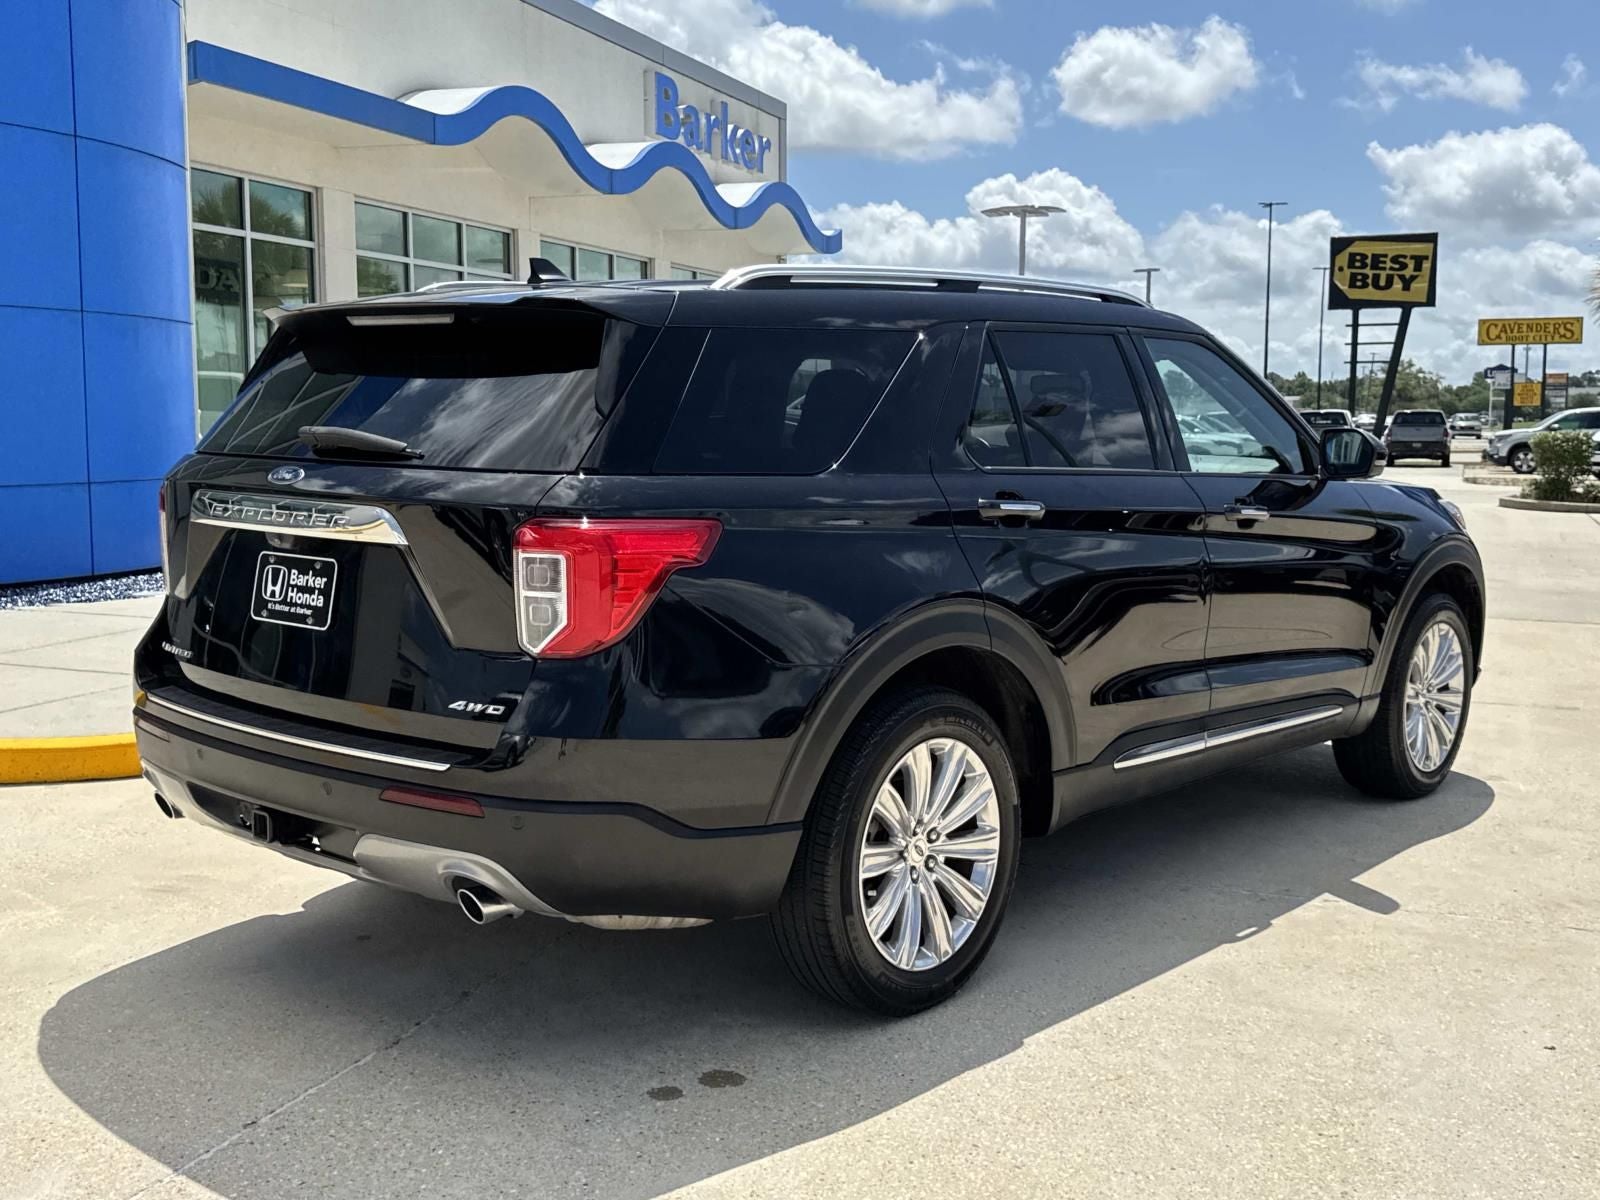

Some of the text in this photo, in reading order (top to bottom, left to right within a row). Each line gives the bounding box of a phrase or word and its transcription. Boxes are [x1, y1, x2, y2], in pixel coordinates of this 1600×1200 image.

[655, 72, 771, 174] Barker
[1347, 252, 1429, 272] BEST
[1348, 272, 1419, 292] BUY
[1486, 321, 1575, 341] CAVENDER'S
[210, 504, 350, 528] EXPLORER
[290, 569, 327, 589] Barker
[287, 587, 324, 607] Honda
[296, 606, 313, 615] Barker
[448, 700, 506, 715] 4WD
